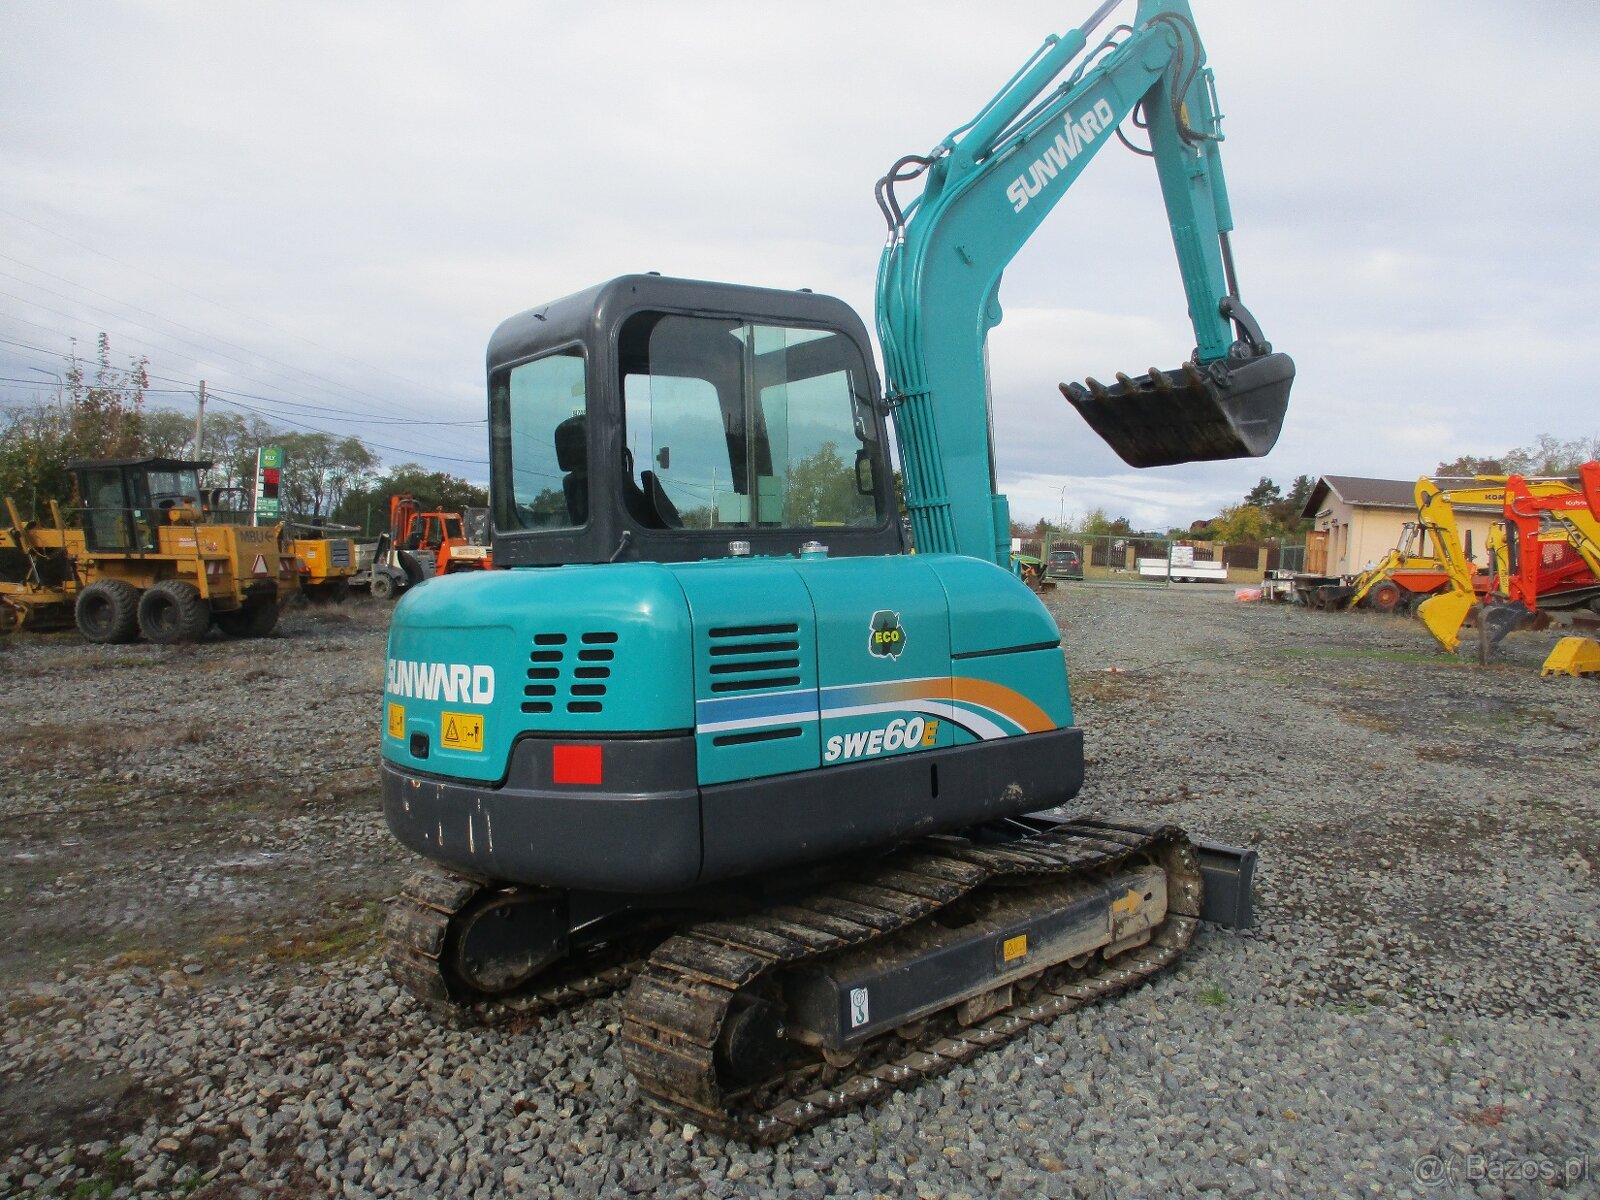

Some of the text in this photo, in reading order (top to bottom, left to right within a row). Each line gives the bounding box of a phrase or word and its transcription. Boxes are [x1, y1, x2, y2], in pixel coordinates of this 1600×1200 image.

[1006, 98, 1114, 214] SUNWARD
[875, 630, 900, 644] ECO
[388, 658, 495, 705] SUNWARD
[824, 716, 939, 761] SWE60E
